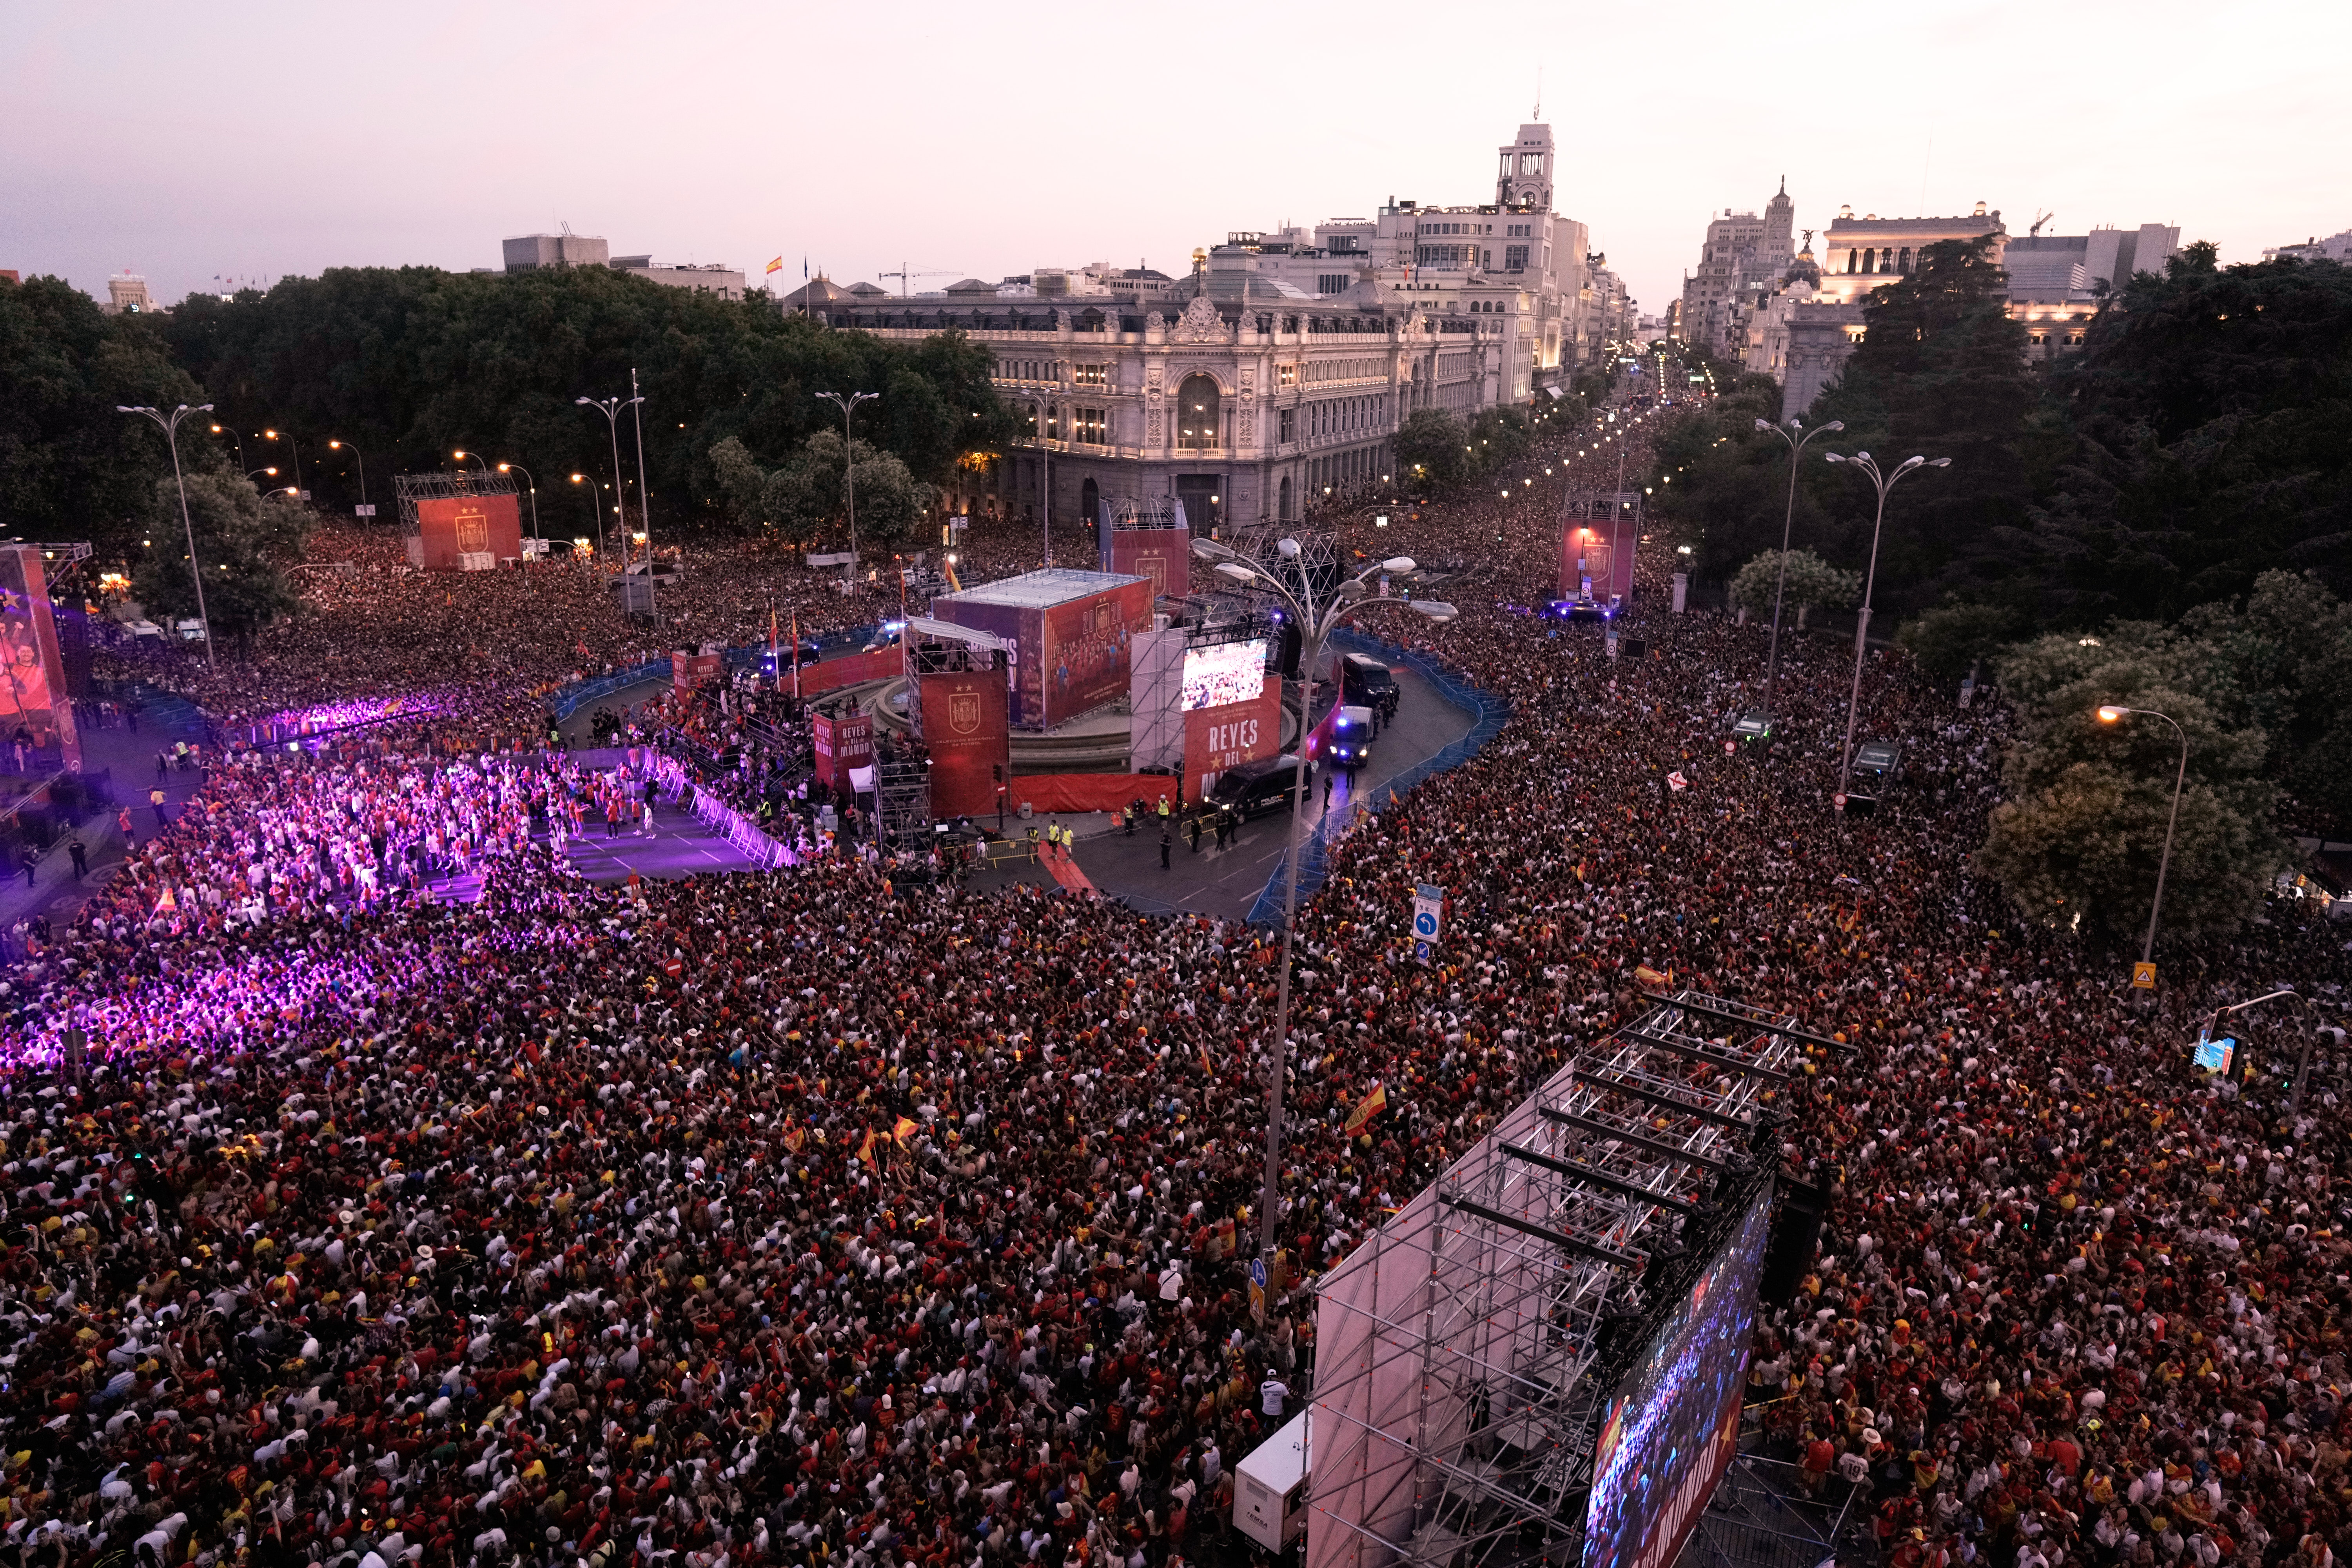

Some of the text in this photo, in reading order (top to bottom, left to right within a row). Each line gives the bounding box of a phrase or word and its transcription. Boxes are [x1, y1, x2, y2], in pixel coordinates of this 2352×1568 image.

[1083, 601, 1122, 634] 20 26
[698, 665, 713, 673] REYES
[817, 724, 829, 739] REYES
[843, 725, 865, 739] REYES
[1209, 719, 1258, 752] REYES
[815, 744, 831, 757] MUNDO
[840, 742, 869, 757] MUNDO
[1225, 751, 1240, 766] DEL
[98, 1034, 107, 1044] 10
[1847, 1463, 1861, 1478] 19
[1654, 1430, 1719, 1568] MUNDO
